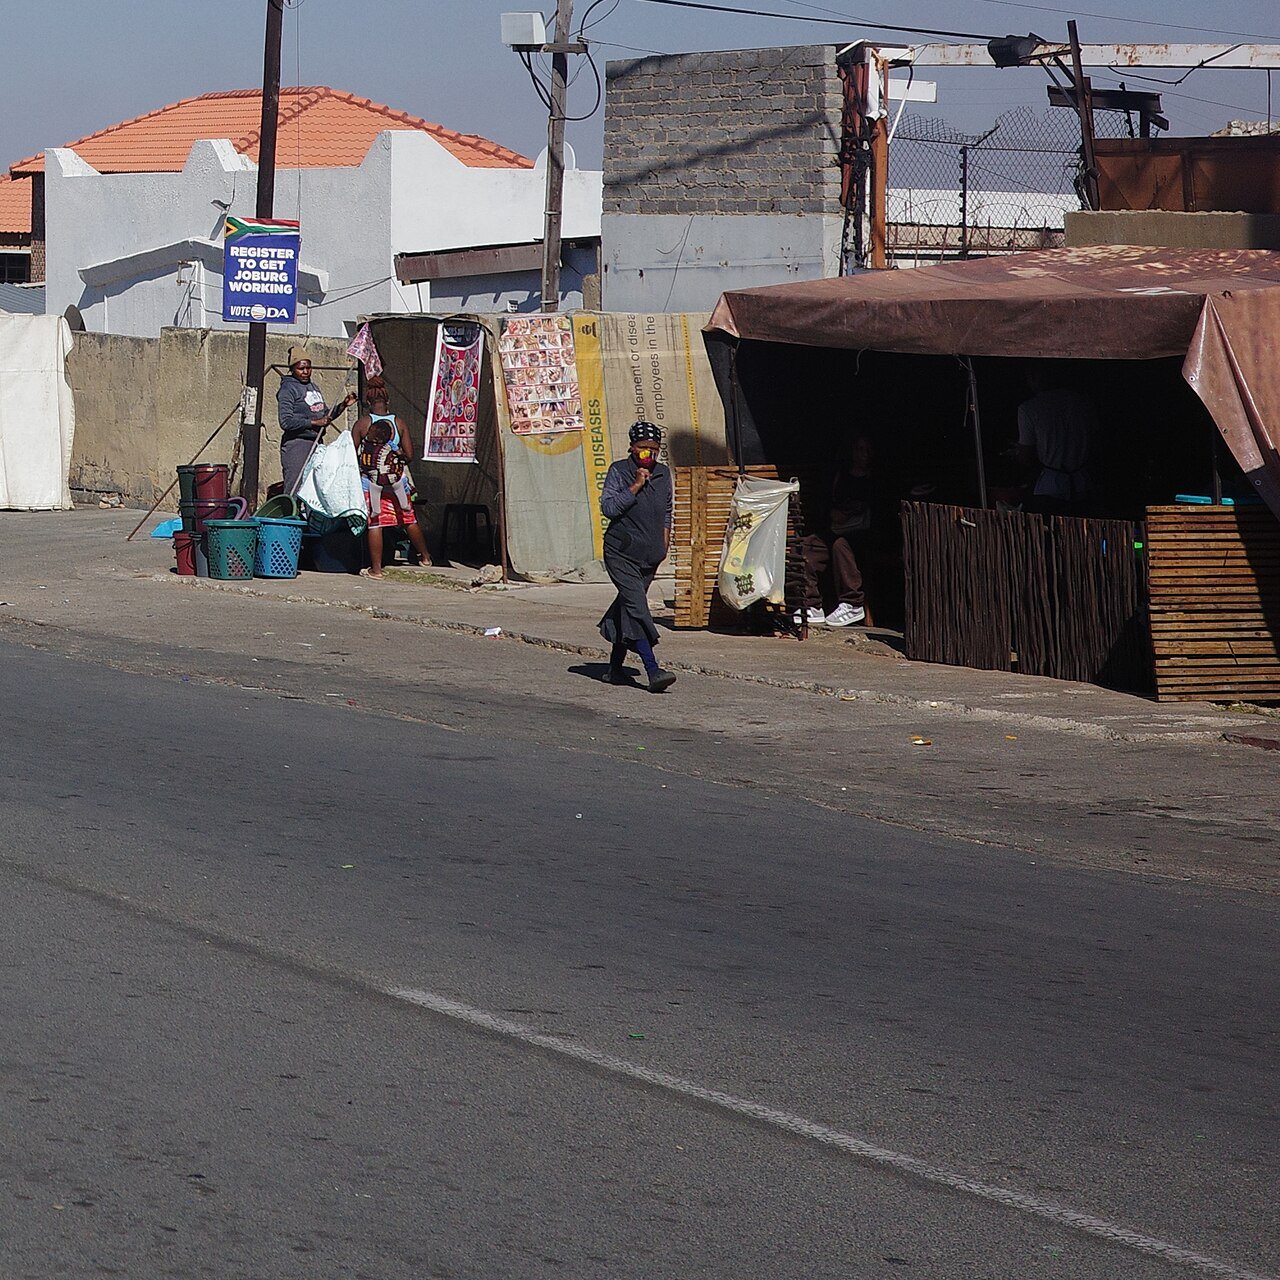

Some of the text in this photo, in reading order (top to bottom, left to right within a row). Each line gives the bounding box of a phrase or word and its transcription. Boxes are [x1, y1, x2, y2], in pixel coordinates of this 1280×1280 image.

[230, 246, 294, 259] REGISTER
[238, 258, 286, 271] TO GET
[234, 271, 288, 283] JOBURG
[229, 281, 293, 295] WORKING
[230, 305, 289, 318] VOTE DA
[645, 315, 656, 335] the
[647, 338, 658, 350] in
[630, 350, 640, 363] or
[650, 353, 665, 420] employees
[588, 398, 606, 468] DISEASES
